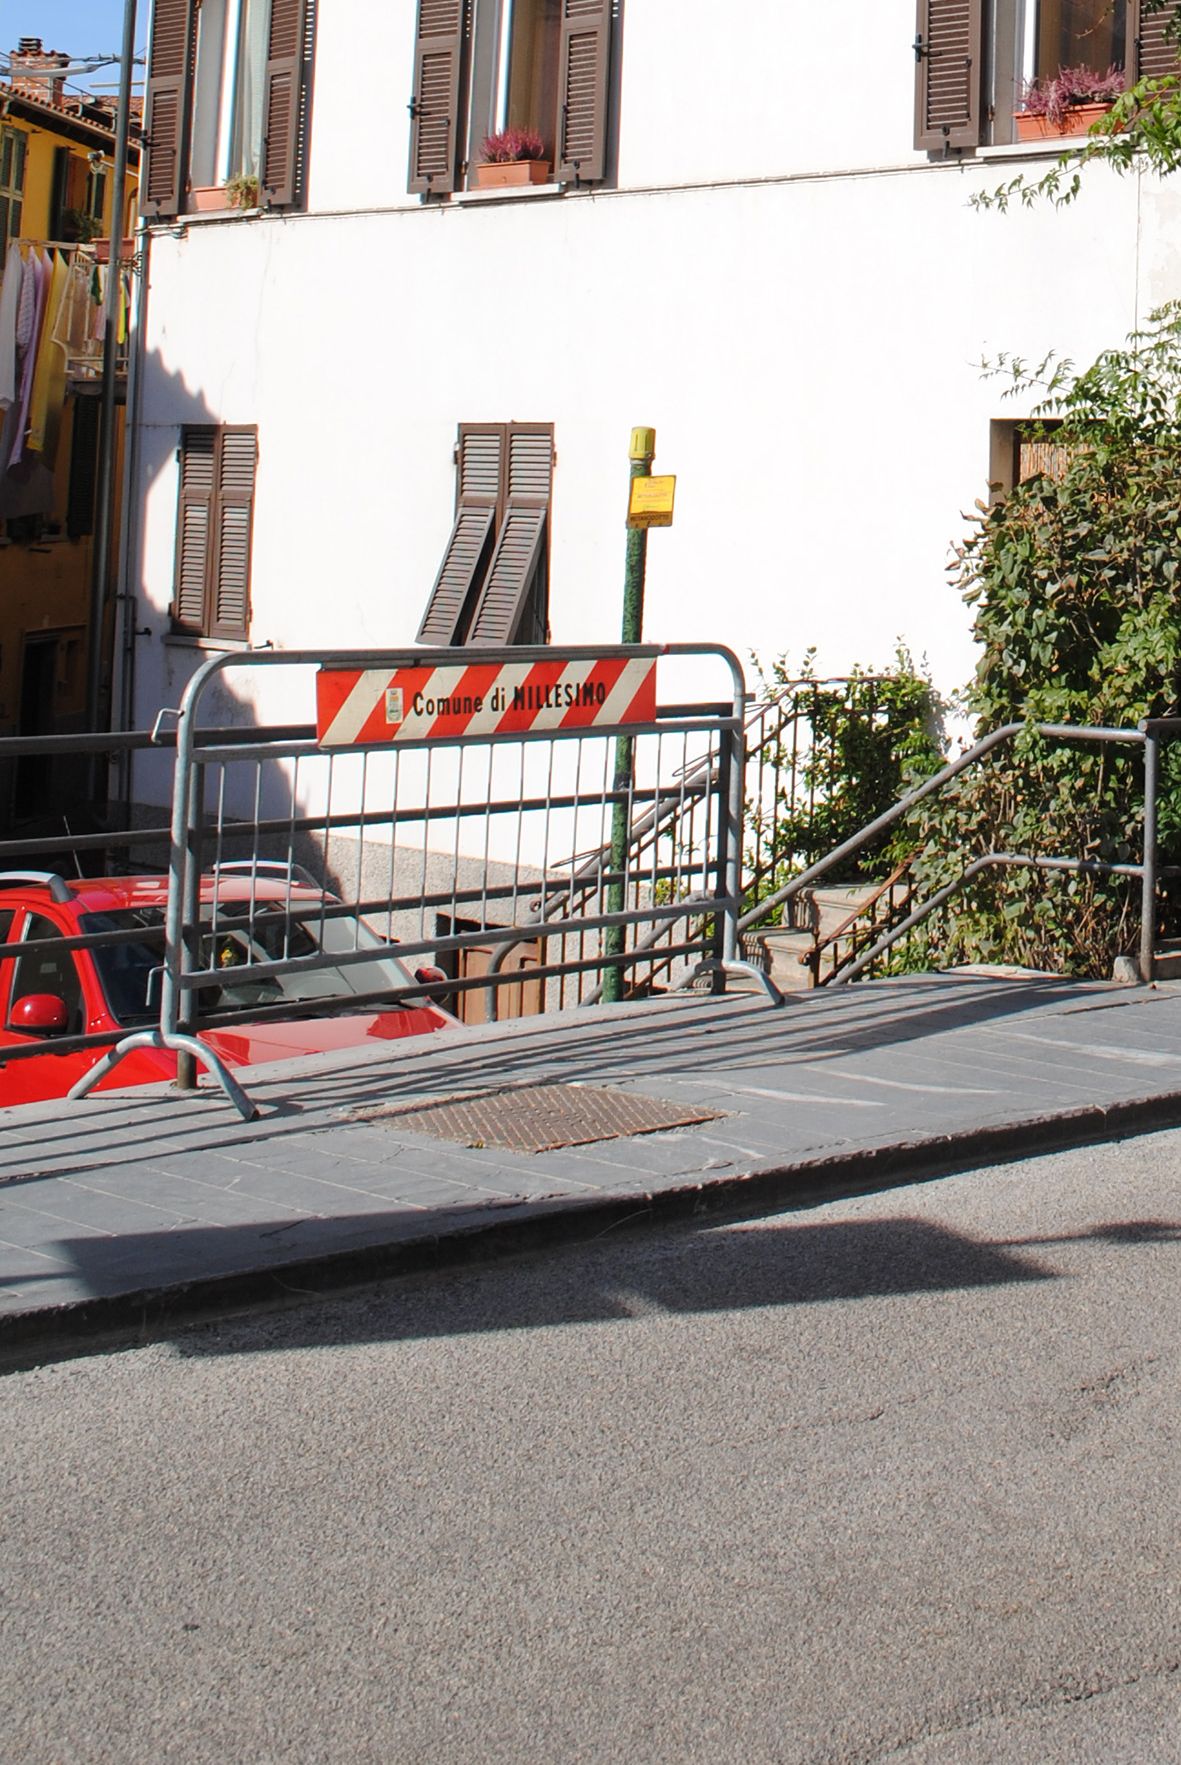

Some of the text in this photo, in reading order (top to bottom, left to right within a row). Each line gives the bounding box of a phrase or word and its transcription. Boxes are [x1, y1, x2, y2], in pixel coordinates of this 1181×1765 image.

[412, 681, 606, 717] Comune di MILLESIMO
